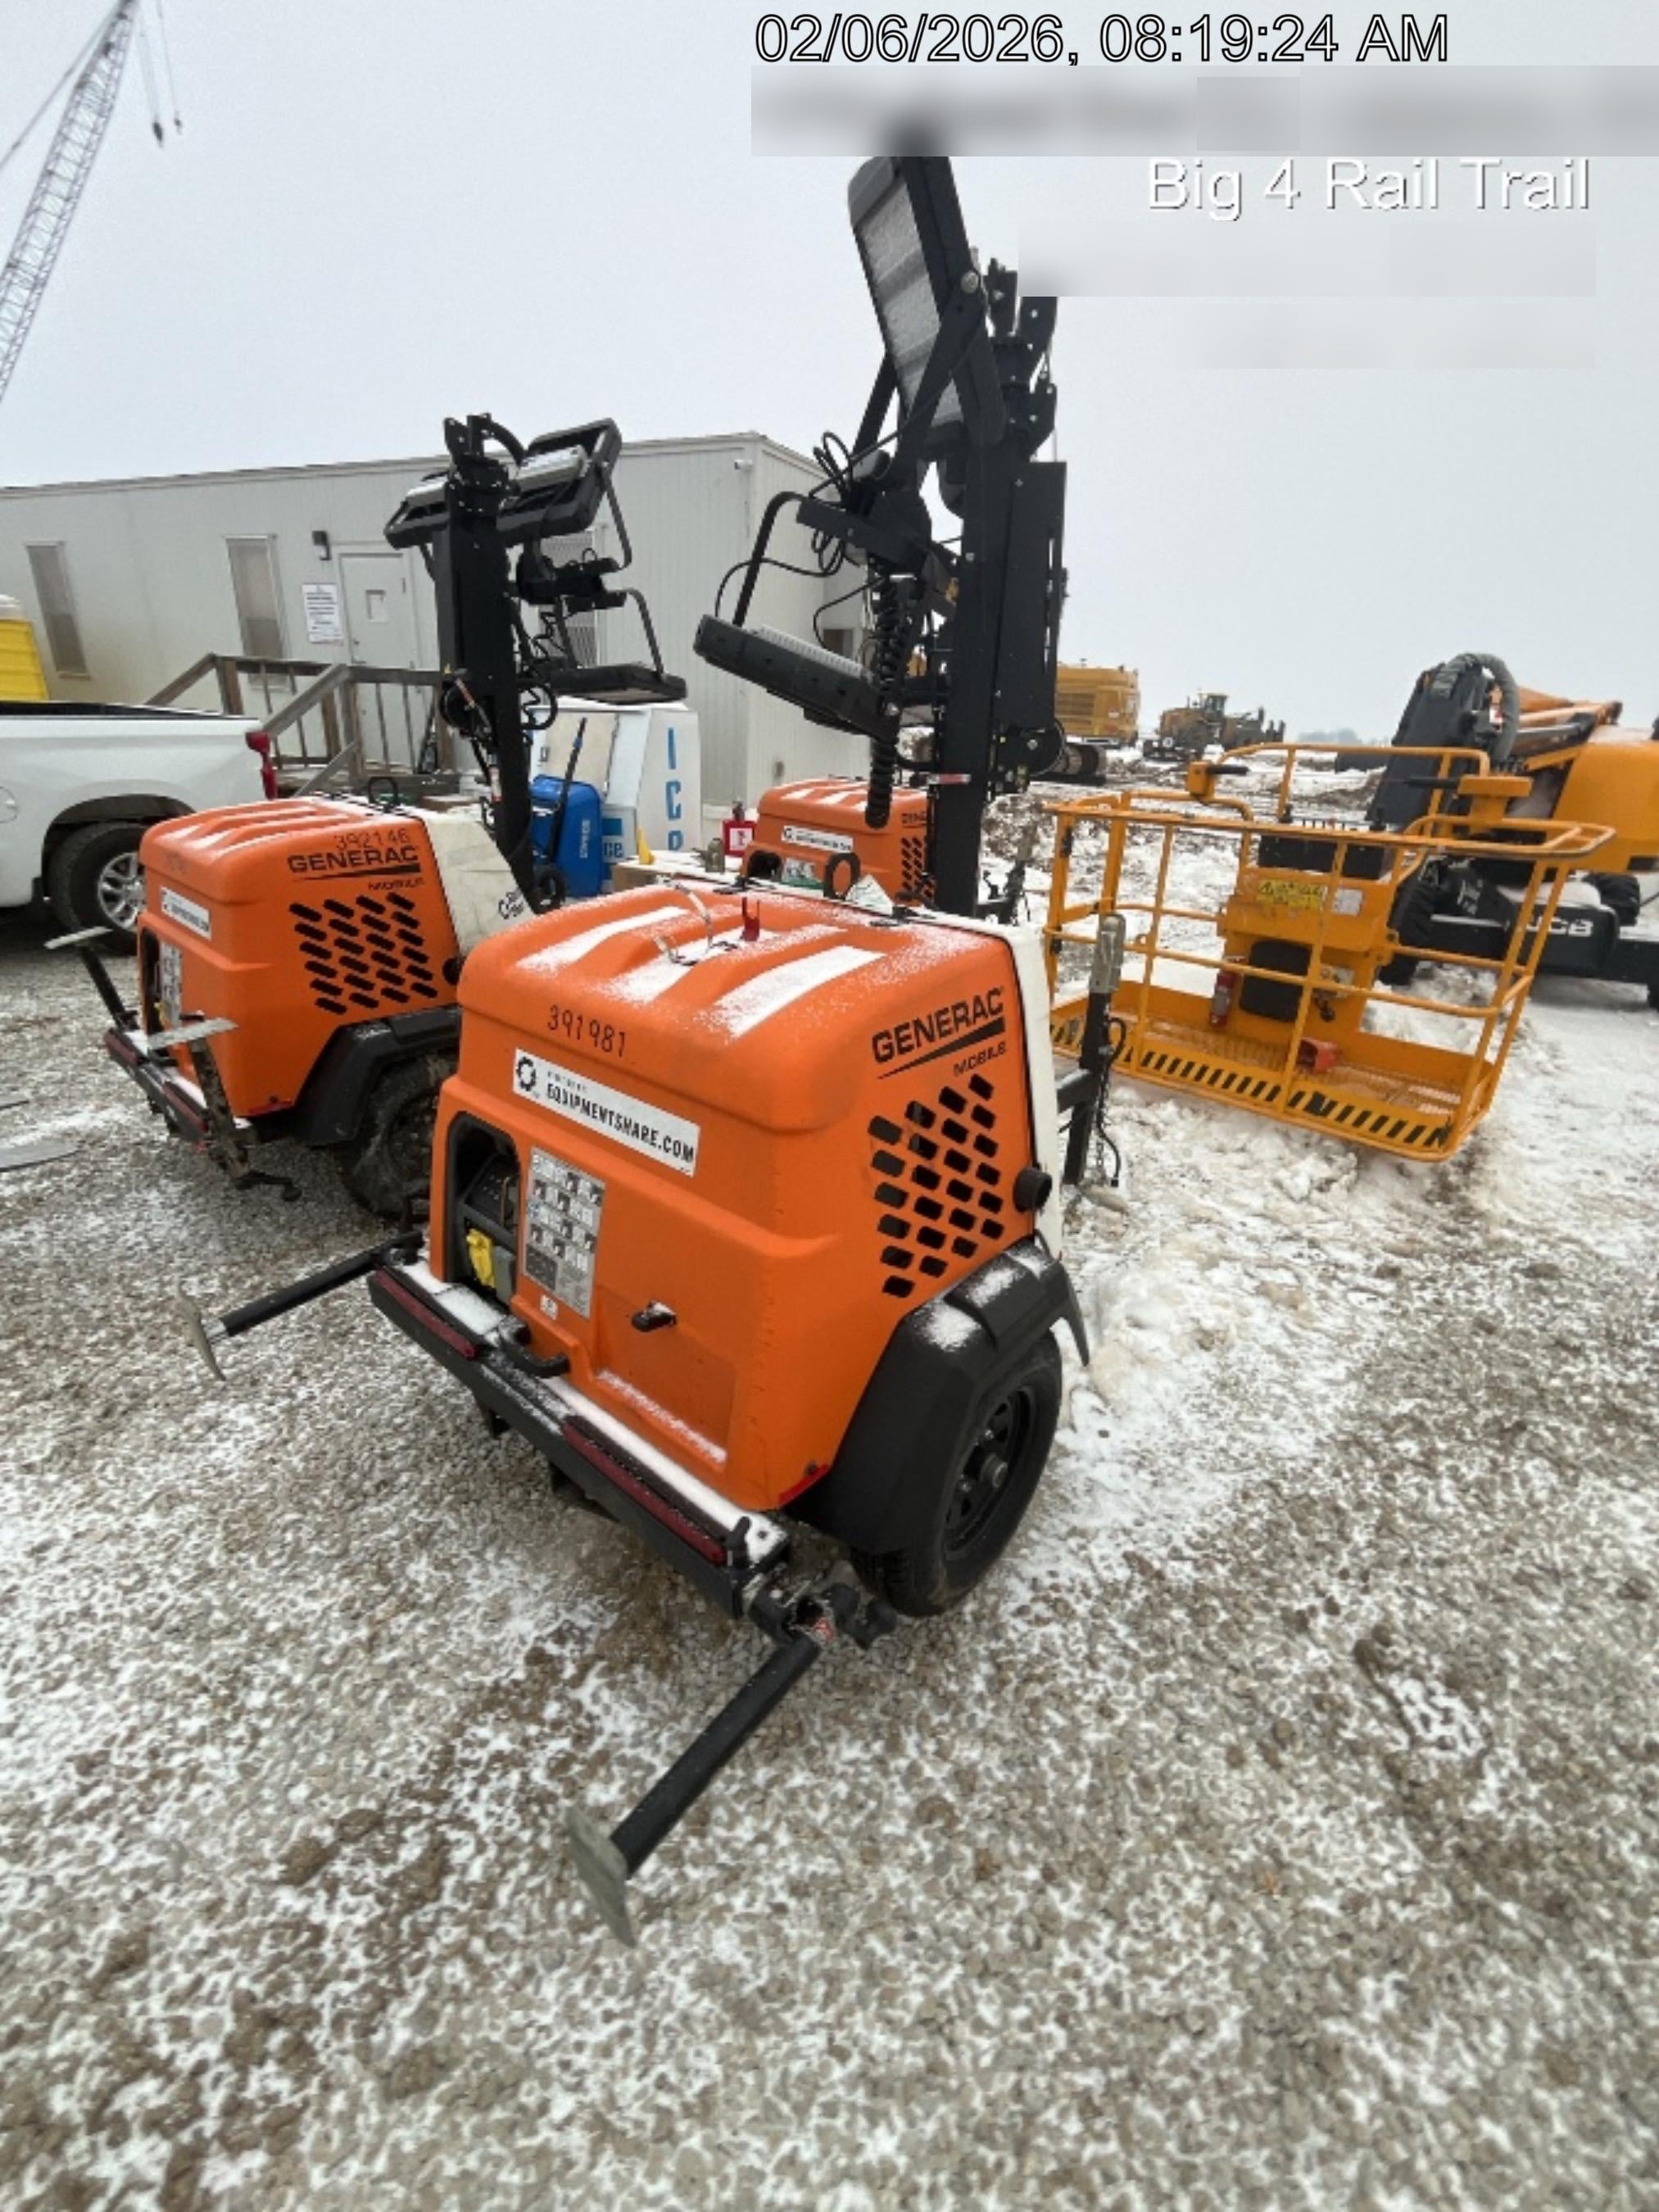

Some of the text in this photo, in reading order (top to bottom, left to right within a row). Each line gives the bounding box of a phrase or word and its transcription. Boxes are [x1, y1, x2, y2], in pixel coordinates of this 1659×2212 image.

[288, 845, 419, 873] GENERAC
[1526, 916, 1593, 937] JCB
[547, 1004, 625, 1058] 391981
[872, 987, 1004, 1064] GENERAC
[953, 1040, 1006, 1077] MOBILE
[546, 1082, 695, 1163] EQUIPMENTSHARE.COM
